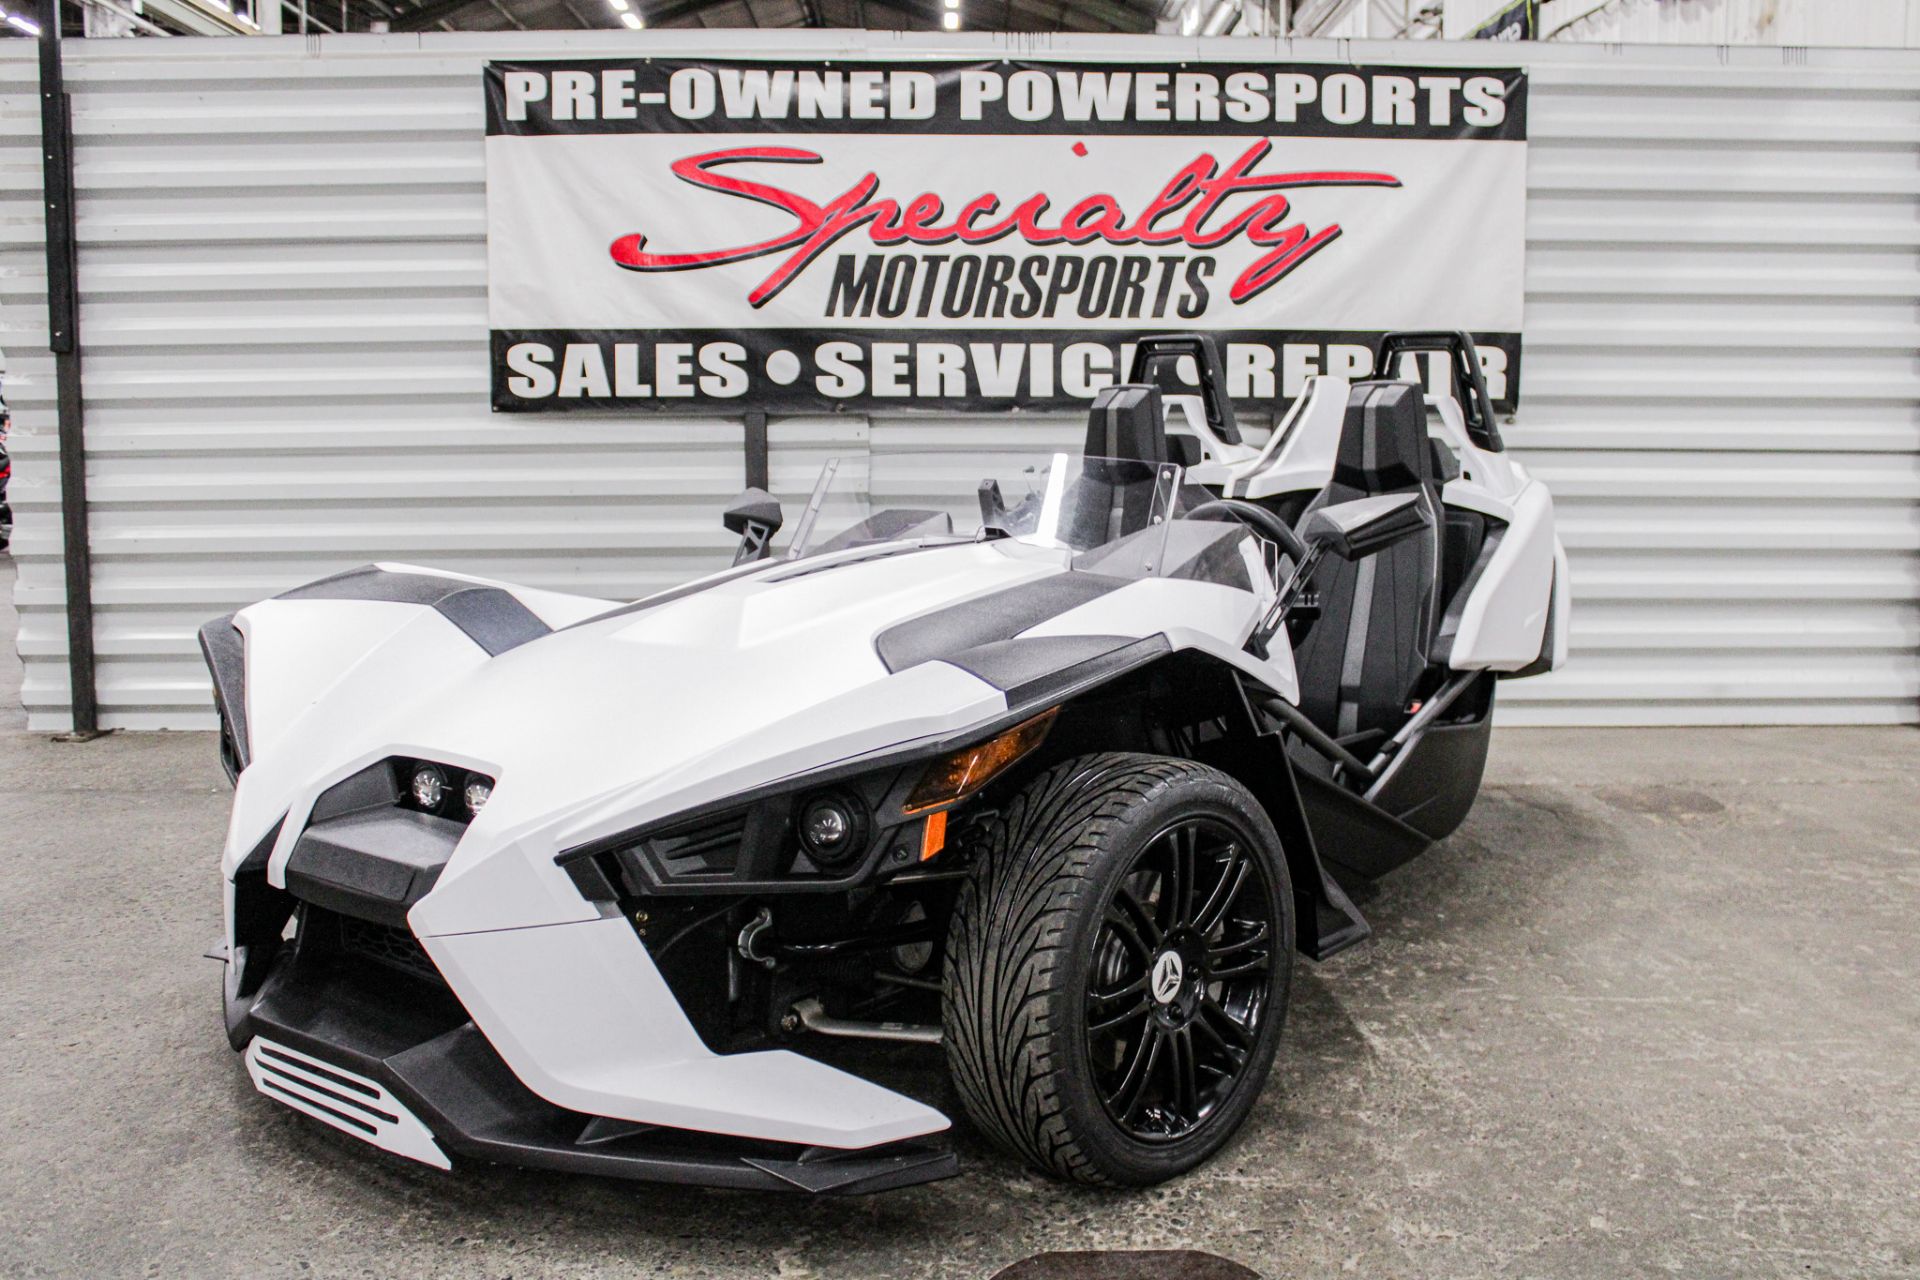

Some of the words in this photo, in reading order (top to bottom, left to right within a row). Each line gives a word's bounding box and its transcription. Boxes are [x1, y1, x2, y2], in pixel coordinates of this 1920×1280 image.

[505, 68, 937, 121] PRE-OWNED
[960, 70, 1506, 127] POWERSPORTS
[608, 137, 1403, 310] Specialty
[825, 254, 1216, 319] MOTORSPORTS
[506, 341, 751, 399] SALES
[814, 340, 1138, 399] SERVIC
